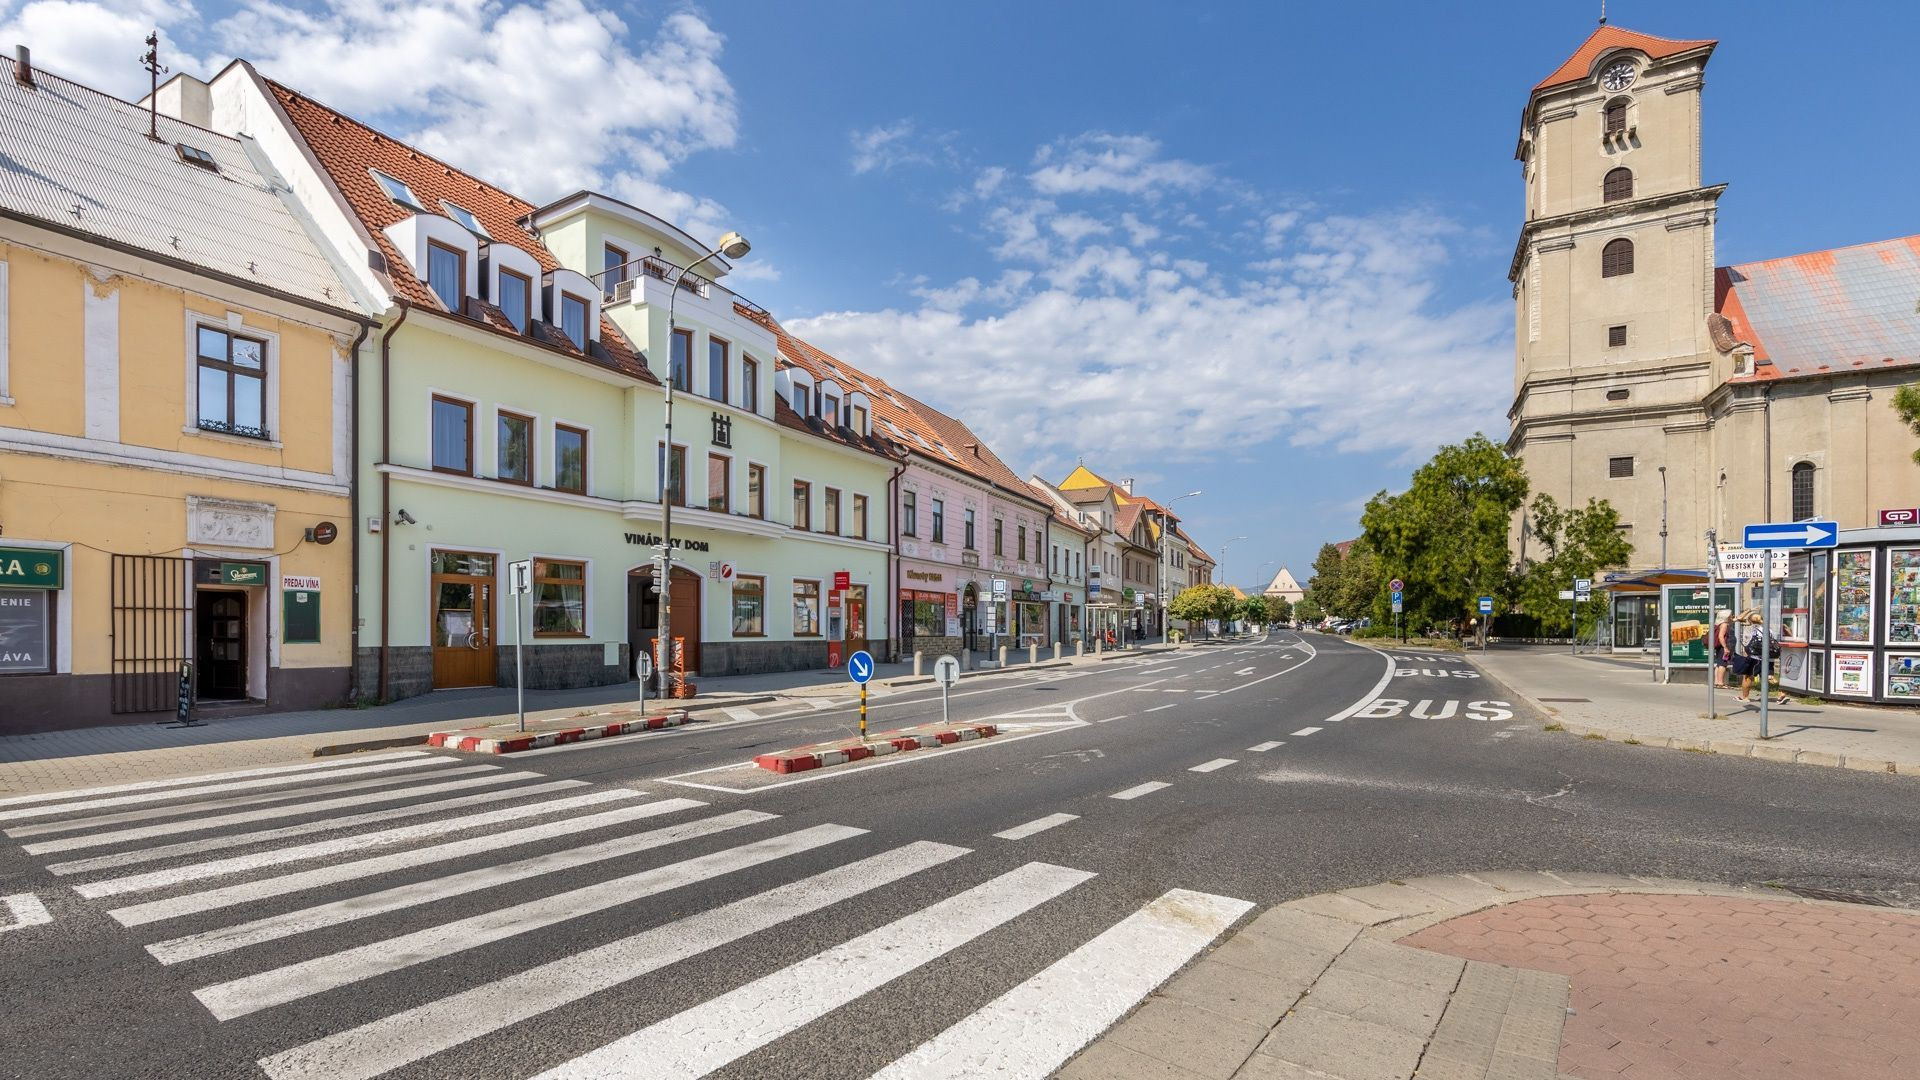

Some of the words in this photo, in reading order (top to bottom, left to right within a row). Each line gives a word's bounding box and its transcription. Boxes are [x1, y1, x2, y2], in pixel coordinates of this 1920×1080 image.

[624, 533, 681, 548] VINÁRKY
[684, 540, 709, 552] DOM
[1727, 552, 1757, 560] OBVODNÝ
[1760, 551, 1778, 559] ÚD
[0, 559, 25, 576] A
[284, 577, 304, 588] PREDAJ
[305, 577, 320, 589] VÍNA
[0, 651, 32, 661] ÁVA
[1393, 668, 1481, 679] BUS
[1352, 699, 1513, 721] BUS
